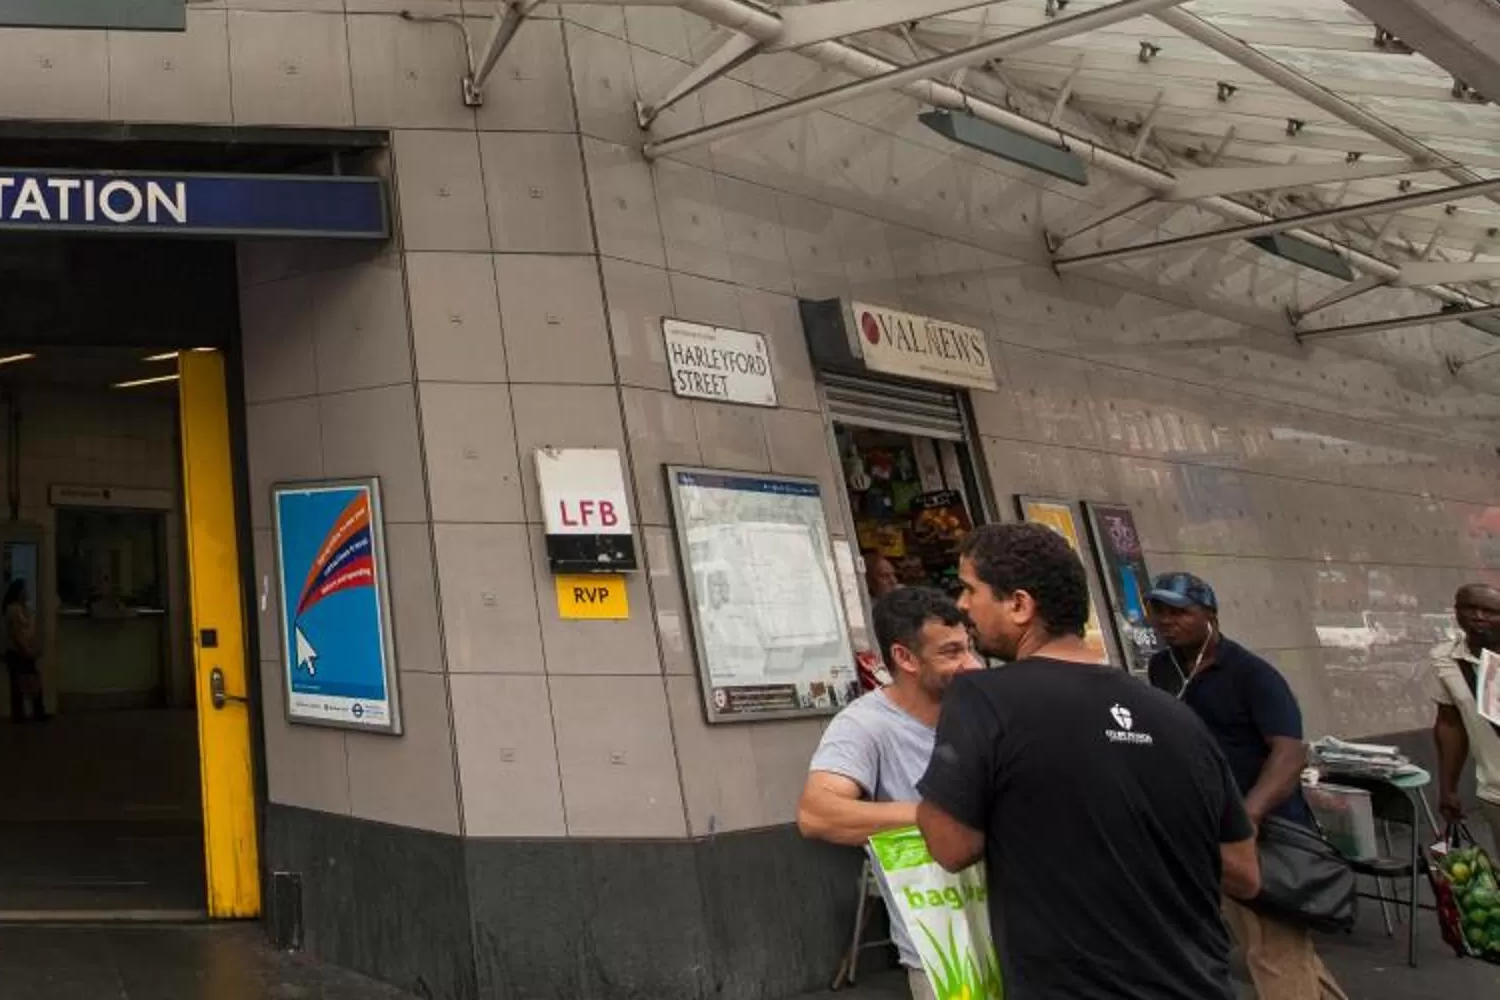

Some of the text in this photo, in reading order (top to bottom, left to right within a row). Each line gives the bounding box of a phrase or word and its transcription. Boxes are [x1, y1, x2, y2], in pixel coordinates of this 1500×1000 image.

[671, 342, 767, 377] HARLEYFORD
[925, 323, 987, 368] NEWS
[676, 368, 729, 397] STREET
[559, 499, 618, 527] LFB
[572, 586, 609, 605] RVP
[902, 884, 964, 911] bag
